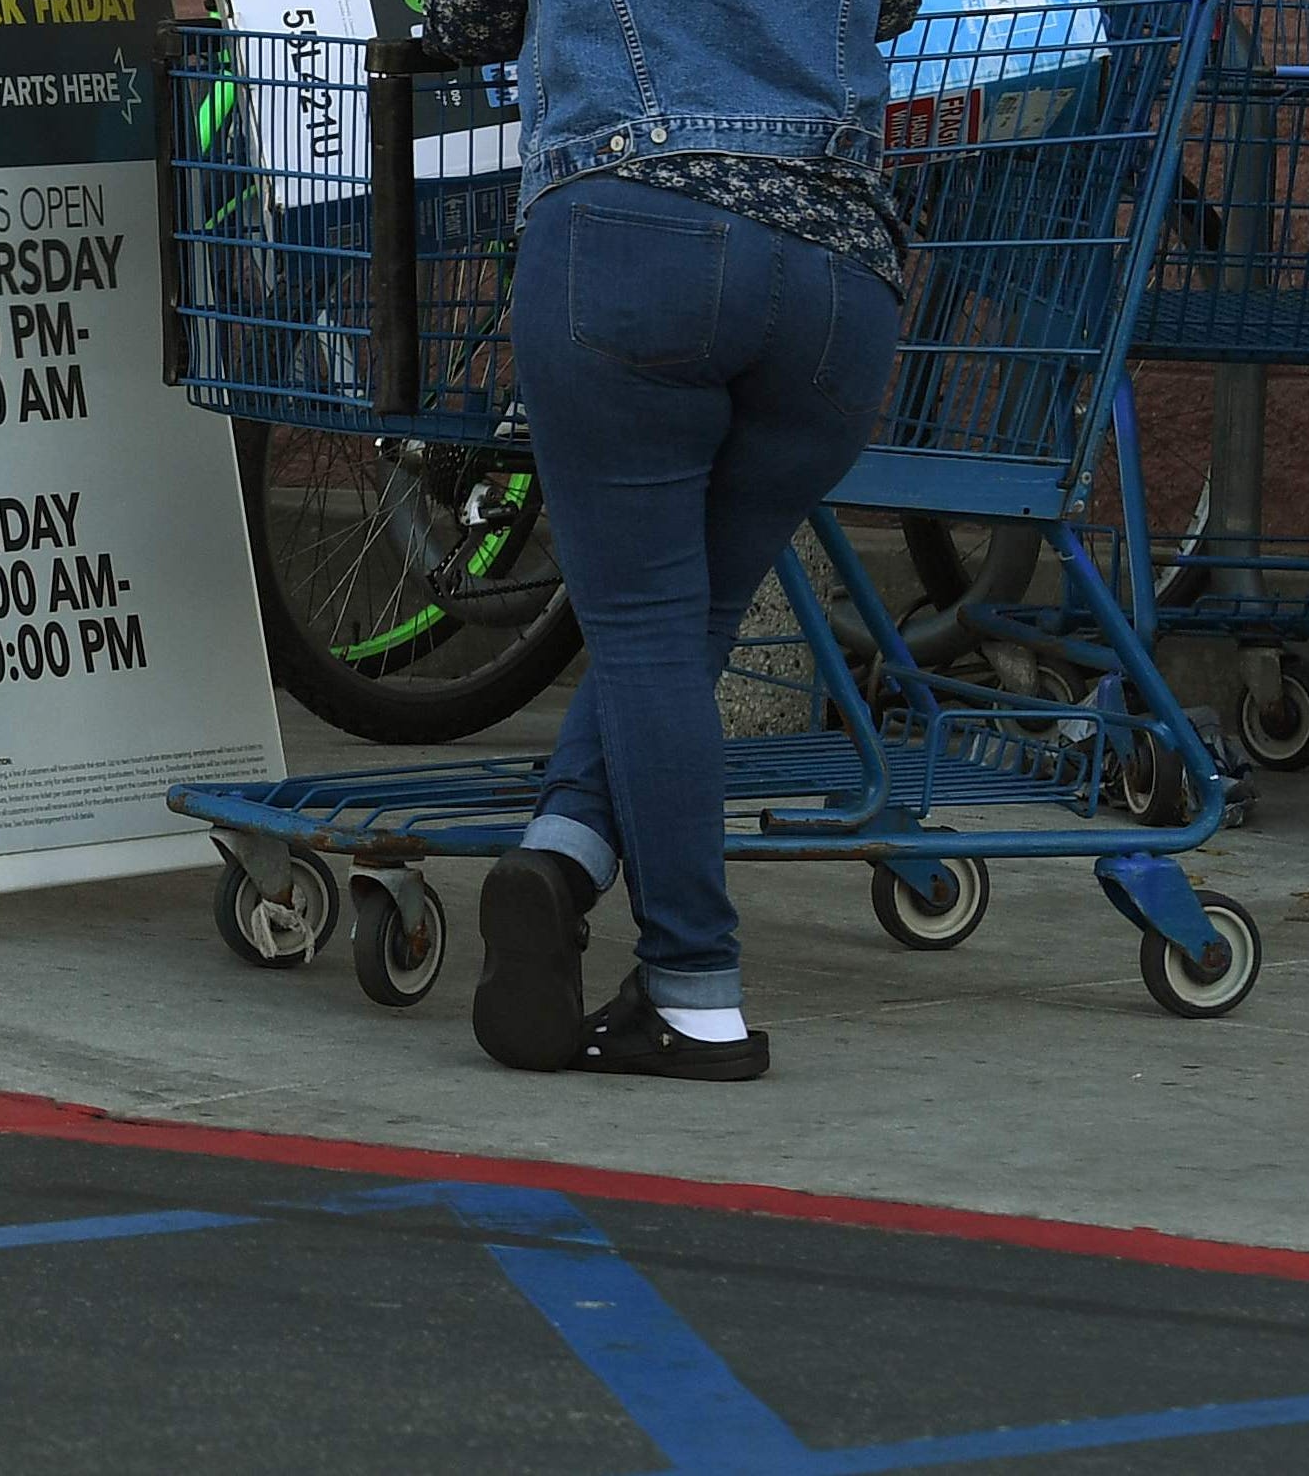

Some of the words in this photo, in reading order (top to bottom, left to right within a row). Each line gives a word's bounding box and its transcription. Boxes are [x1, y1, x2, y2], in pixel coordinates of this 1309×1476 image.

[63, 73, 120, 103] HERE
[17, 184, 105, 231] OPEN
[11, 301, 90, 362] PM-
[18, 363, 88, 423] AM
[47, 552, 131, 613] AM-
[80, 613, 148, 674] PM
